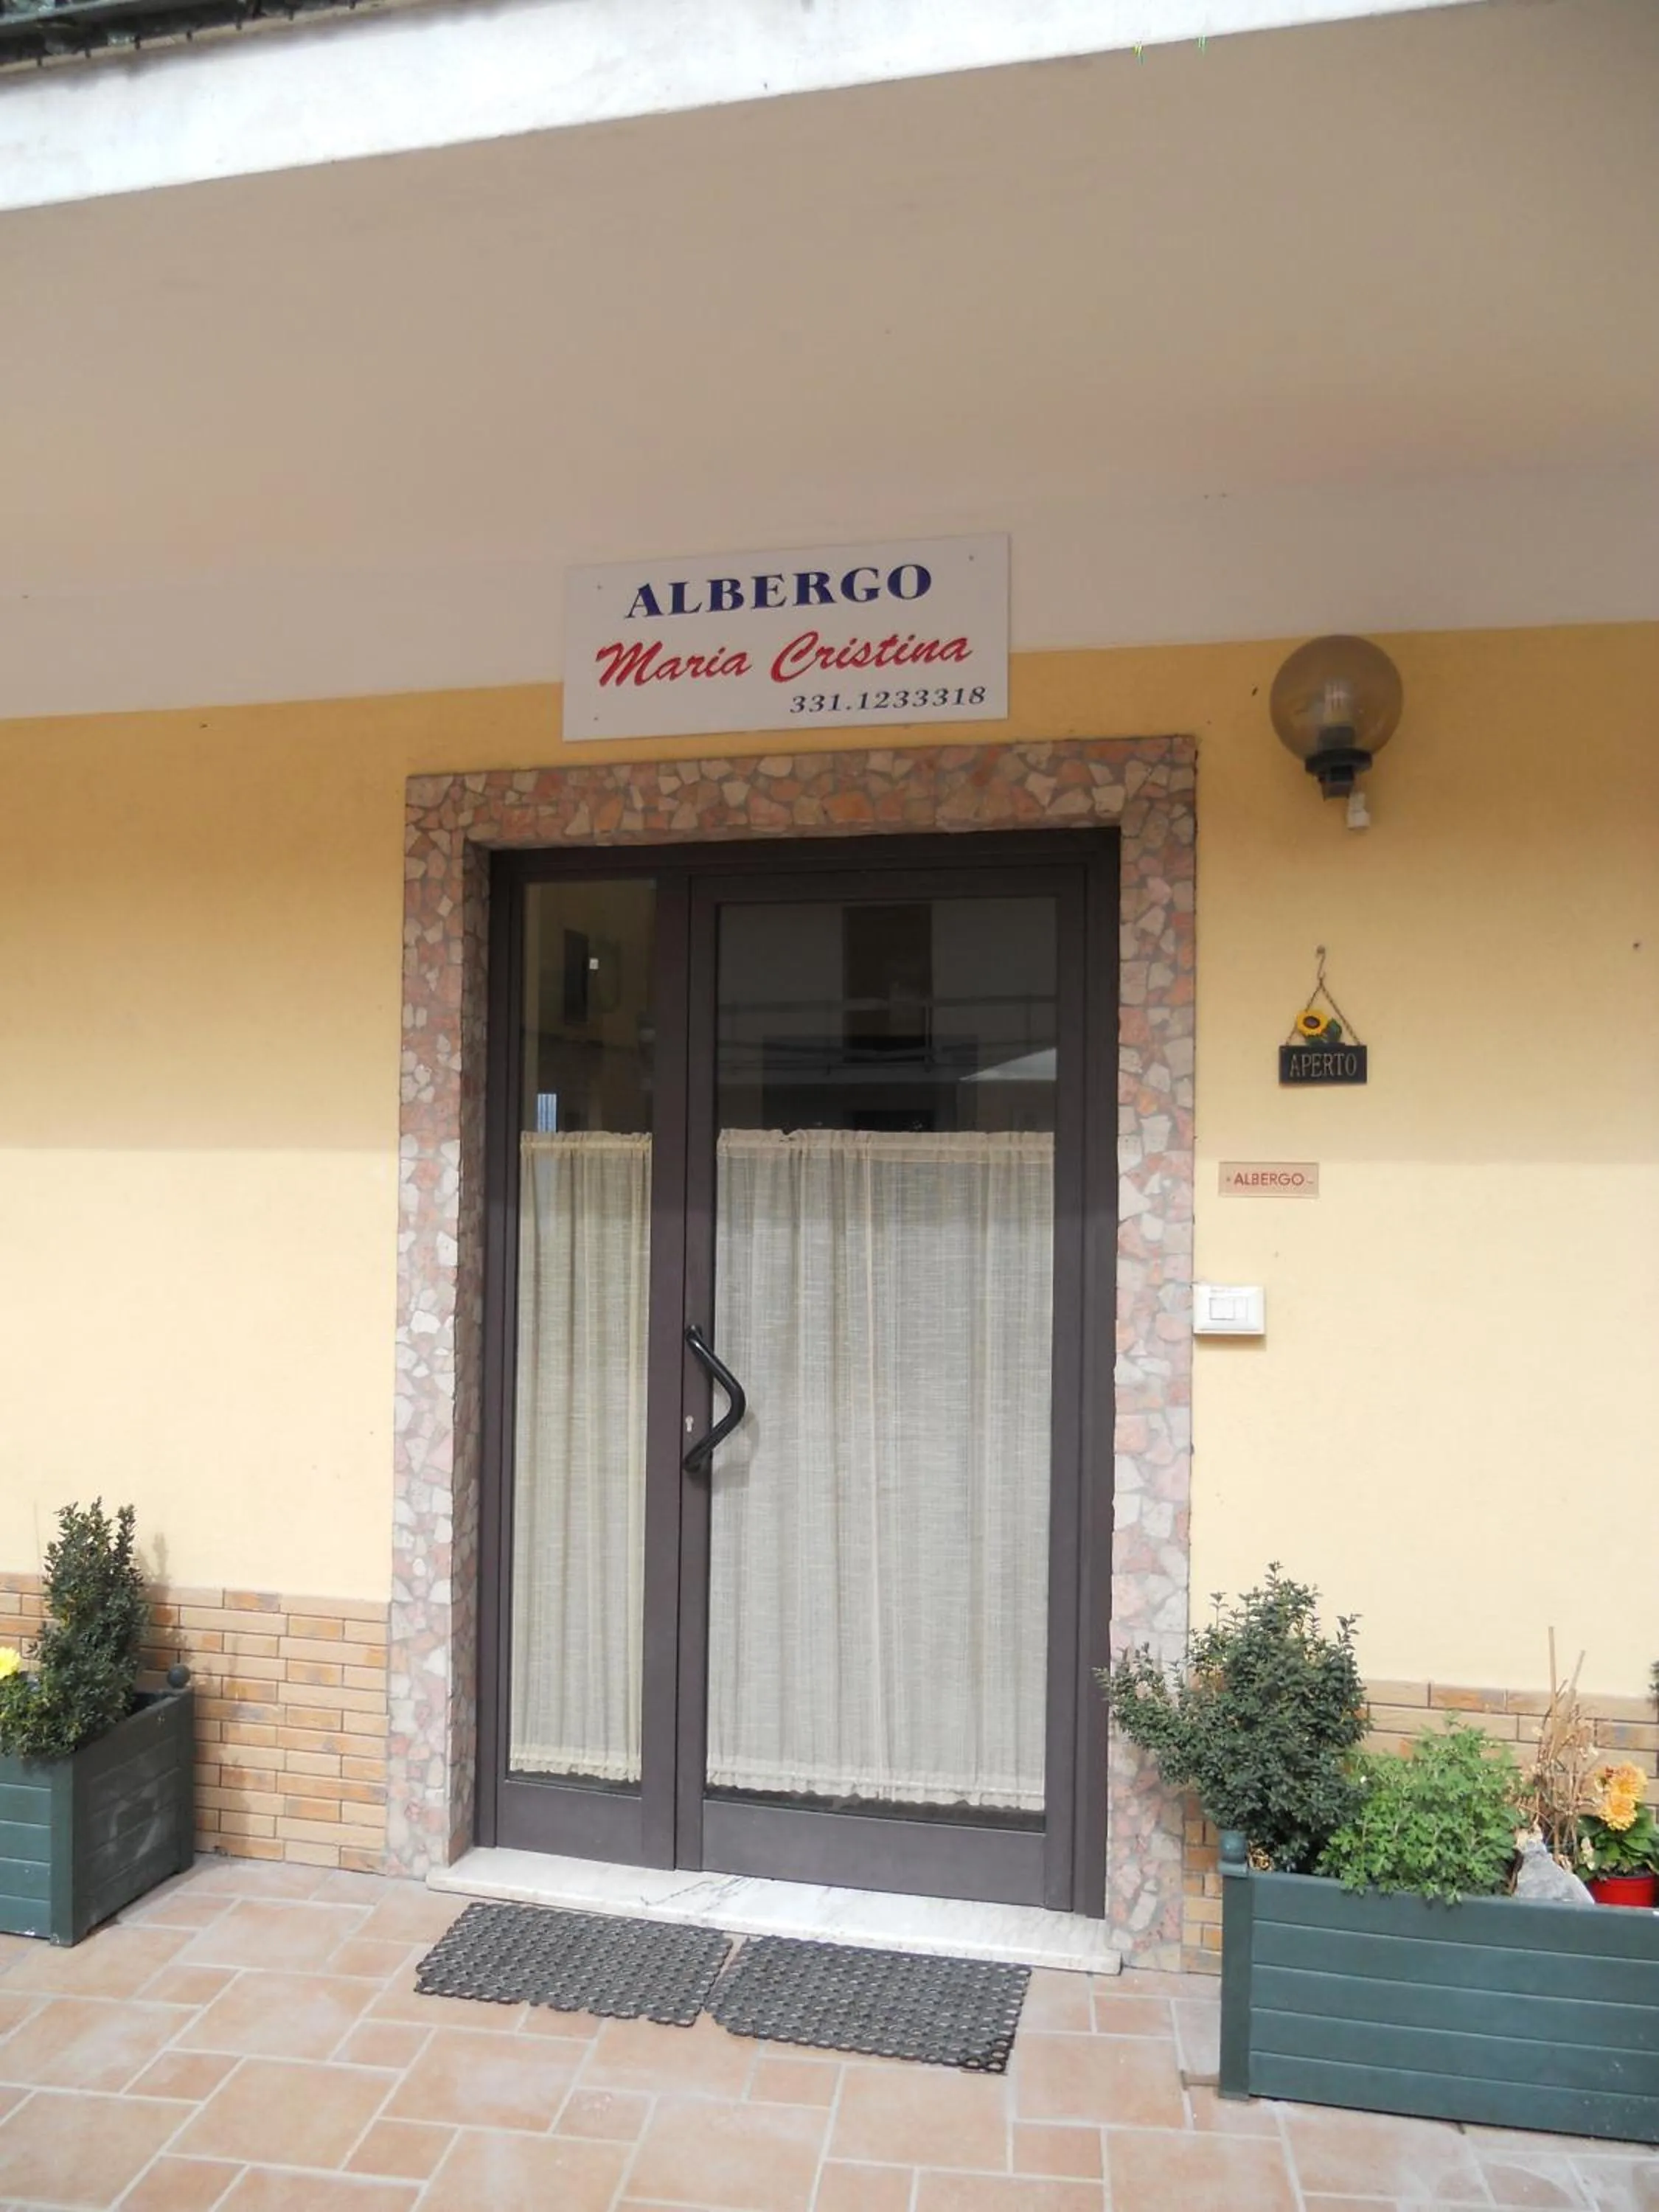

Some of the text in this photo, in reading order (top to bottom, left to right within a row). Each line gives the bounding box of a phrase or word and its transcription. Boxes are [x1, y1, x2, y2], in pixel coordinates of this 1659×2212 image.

[624, 564, 932, 619] ALBERGO
[595, 631, 974, 686] Maria Cristina
[790, 686, 987, 714] 331.1233318
[1290, 1052, 1357, 1077] APERTO
[1234, 1172, 1304, 1186] ALBERGO
